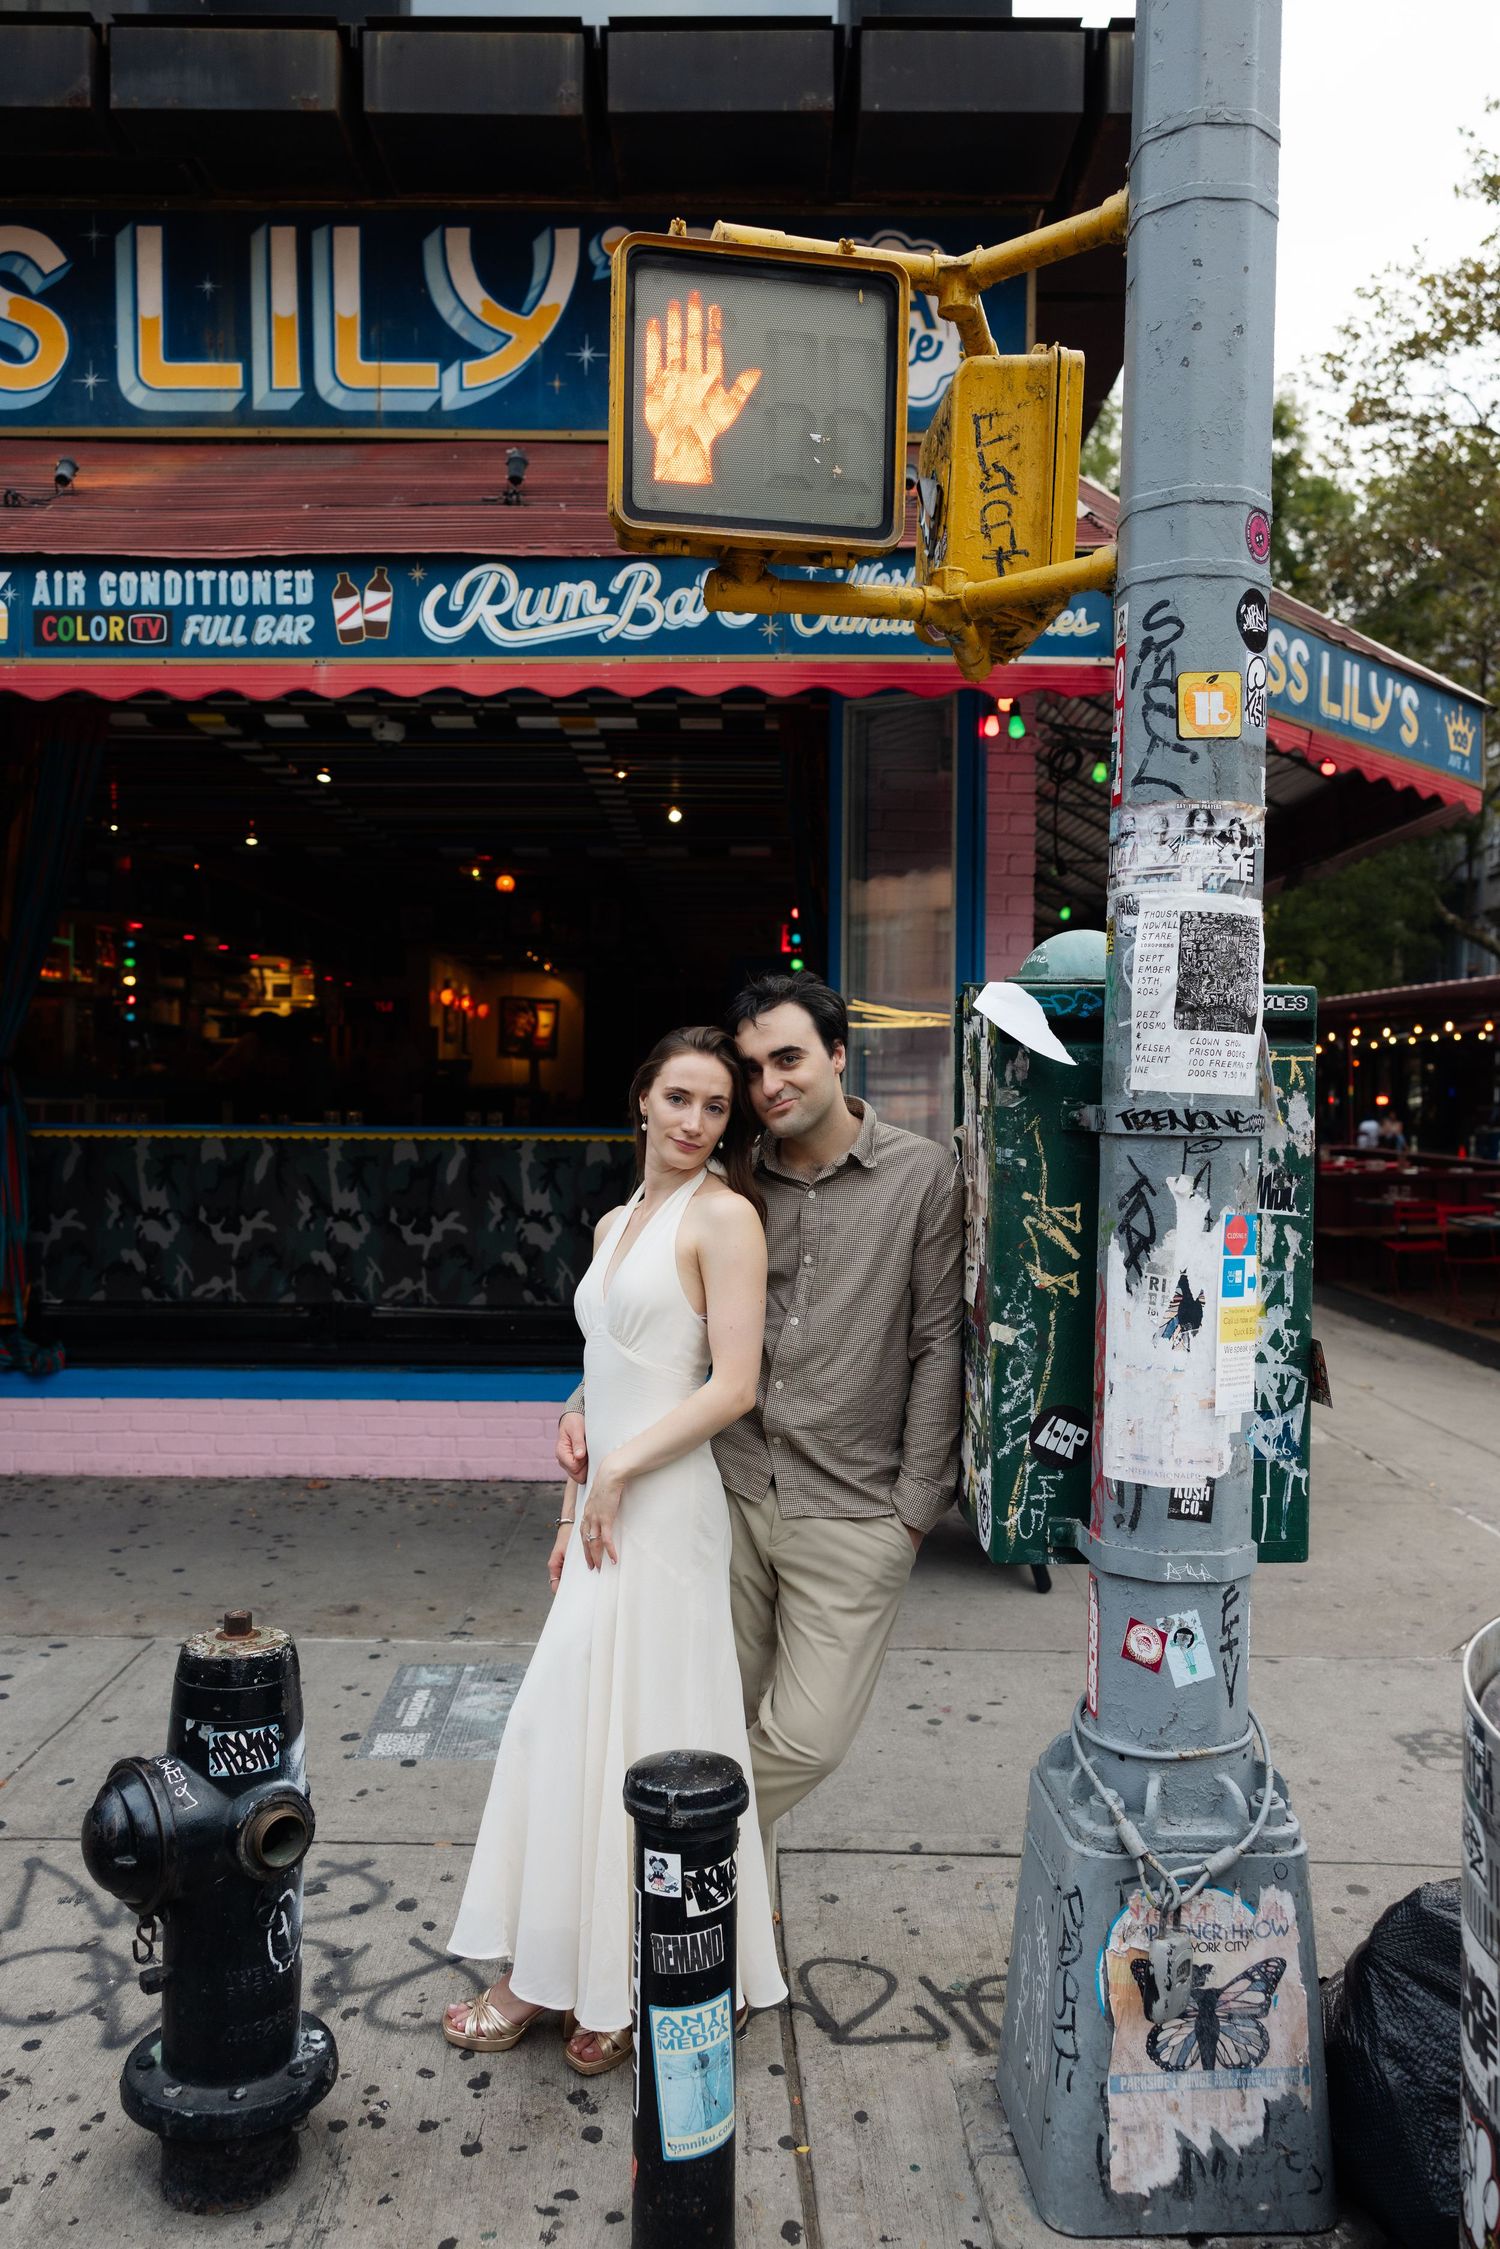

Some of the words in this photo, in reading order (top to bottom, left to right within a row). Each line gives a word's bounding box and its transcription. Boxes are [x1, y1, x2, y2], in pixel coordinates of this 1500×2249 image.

[32, 570, 86, 606] AIR
[99, 570, 314, 606] CONDITIONED
[419, 562, 612, 648] Rum
[41, 615, 124, 642] COLOR
[132, 618, 162, 640] TV
[182, 614, 247, 646] FULL
[252, 614, 315, 645] BAR
[1319, 650, 1420, 748] LILY'S
[1143, 910, 1178, 919] THOUSA
[1142, 921, 1178, 930] NDWALL
[1141, 932, 1173, 941] STARE
[1138, 954, 1165, 963] SEPT
[1138, 966, 1172, 974] EMBER
[1136, 988, 1160, 997] 2025
[1136, 1010, 1161, 1019] DEZY
[1136, 1021, 1167, 1030] KOSMO
[1189, 1037, 1220, 1046] CLOWN
[1136, 1043, 1171, 1053] KELSEA
[1189, 1047, 1222, 1056] PRISON
[1136, 1055, 1170, 1064] VALENT
[1188, 1058, 1205, 1067] 100
[1134, 1066, 1149, 1074] INE
[1187, 1069, 1218, 1078] DOORS
[1034, 1415, 1089, 1459] LOOP
[1180, 1500, 1203, 1516] CO.
[652, 1924, 724, 1974] REMAND
[1190, 1941, 1220, 1954] YORK
[1224, 1940, 1250, 1953] CITY
[656, 1999, 728, 2028] ANTI
[657, 2014, 729, 2039] SOCIAL
[658, 2026, 729, 2051] MEDIA
[669, 2117, 735, 2152] omniku.com
